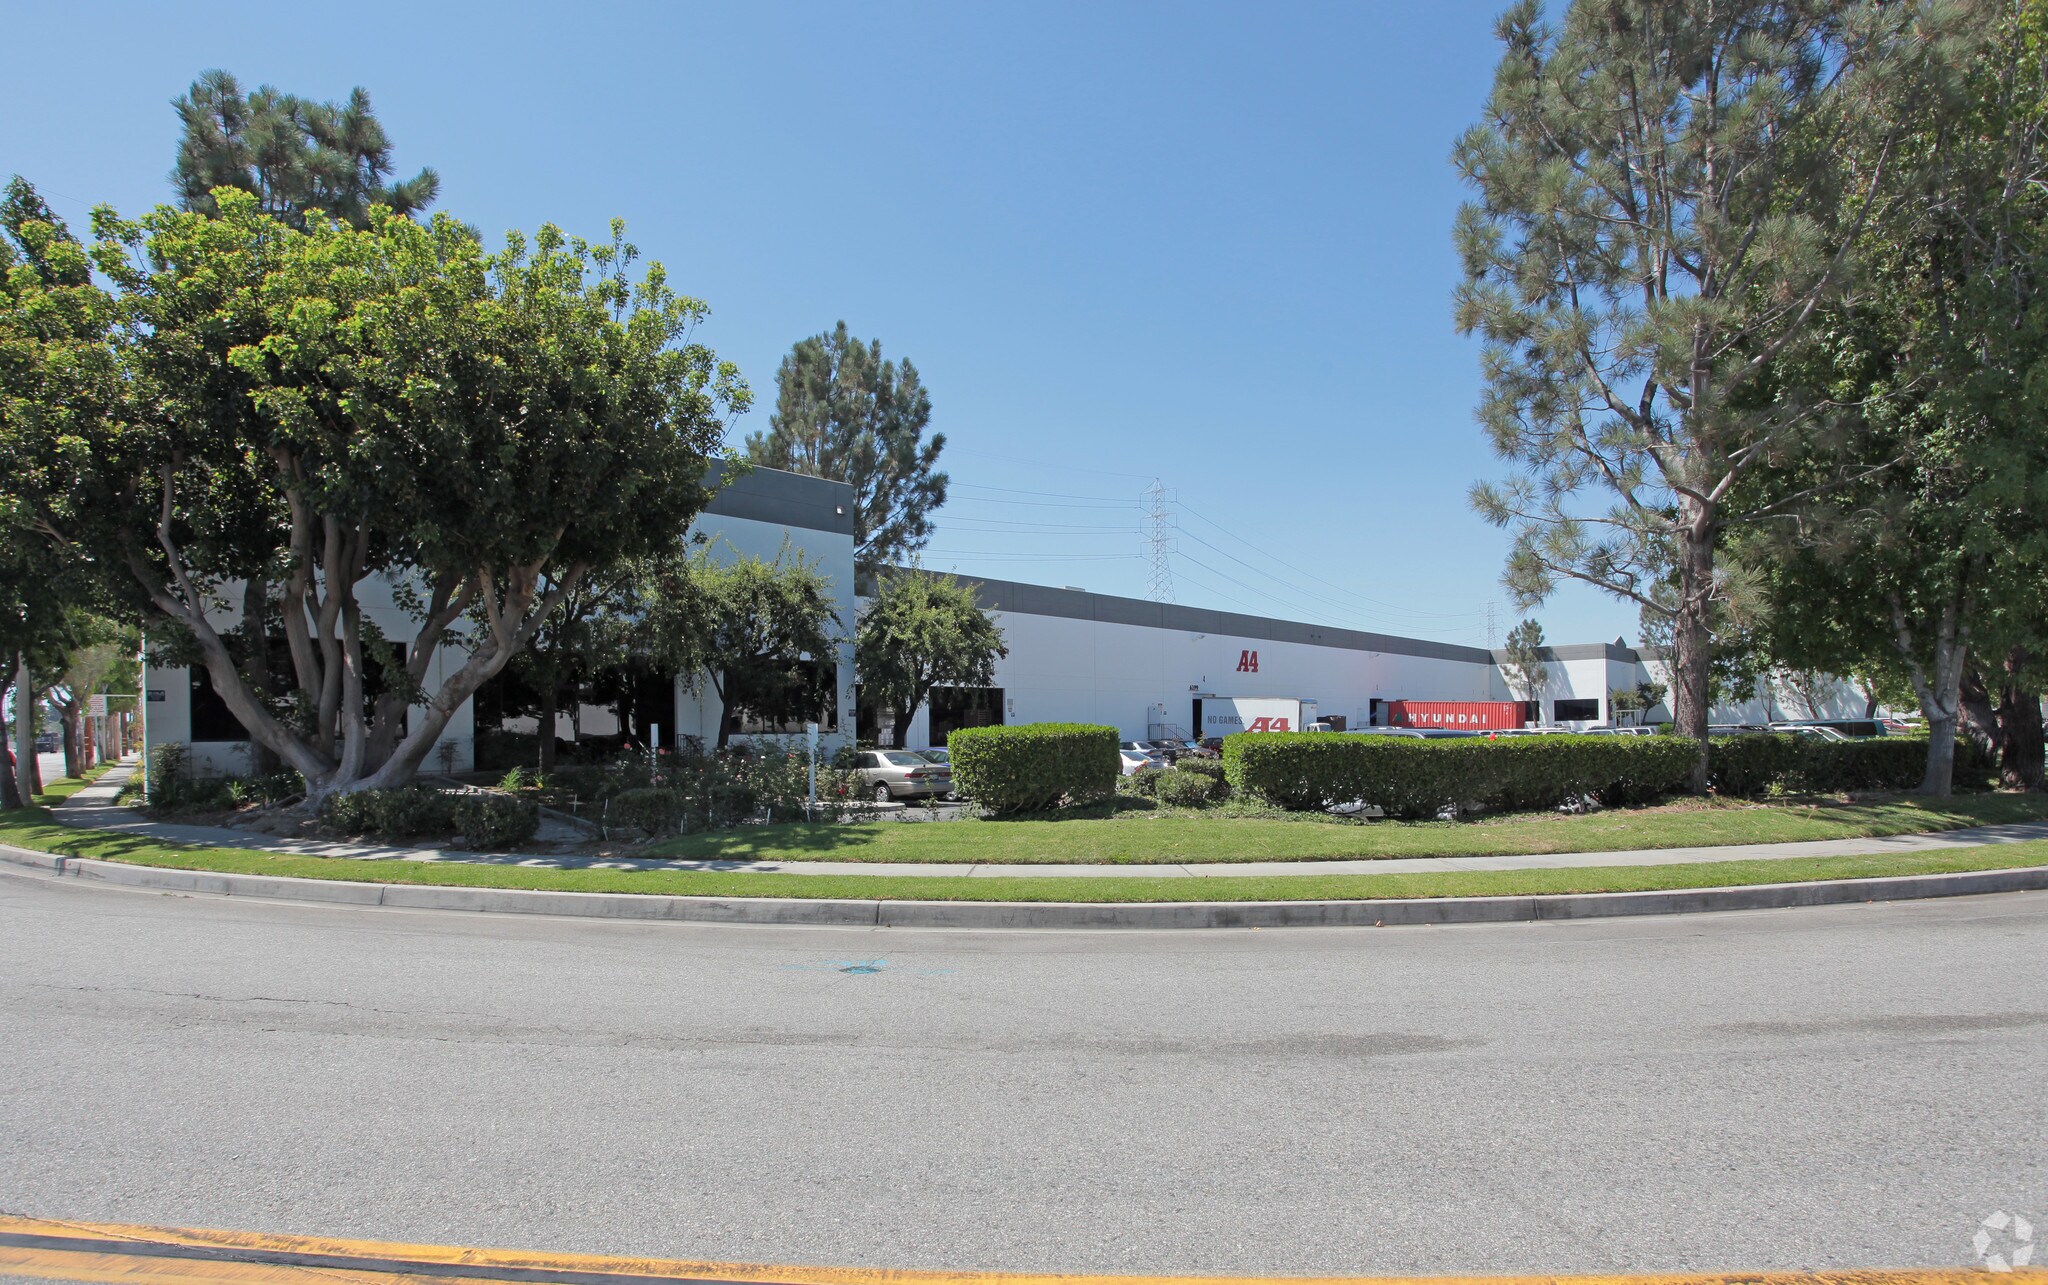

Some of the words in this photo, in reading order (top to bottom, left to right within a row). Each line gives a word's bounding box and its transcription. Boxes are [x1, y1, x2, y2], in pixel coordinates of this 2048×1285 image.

[1236, 650, 1259, 673] A4
[1207, 715, 1217, 724] NO
[1246, 717, 1291, 733] A4
[1408, 713, 1487, 724] HYUNDAI
